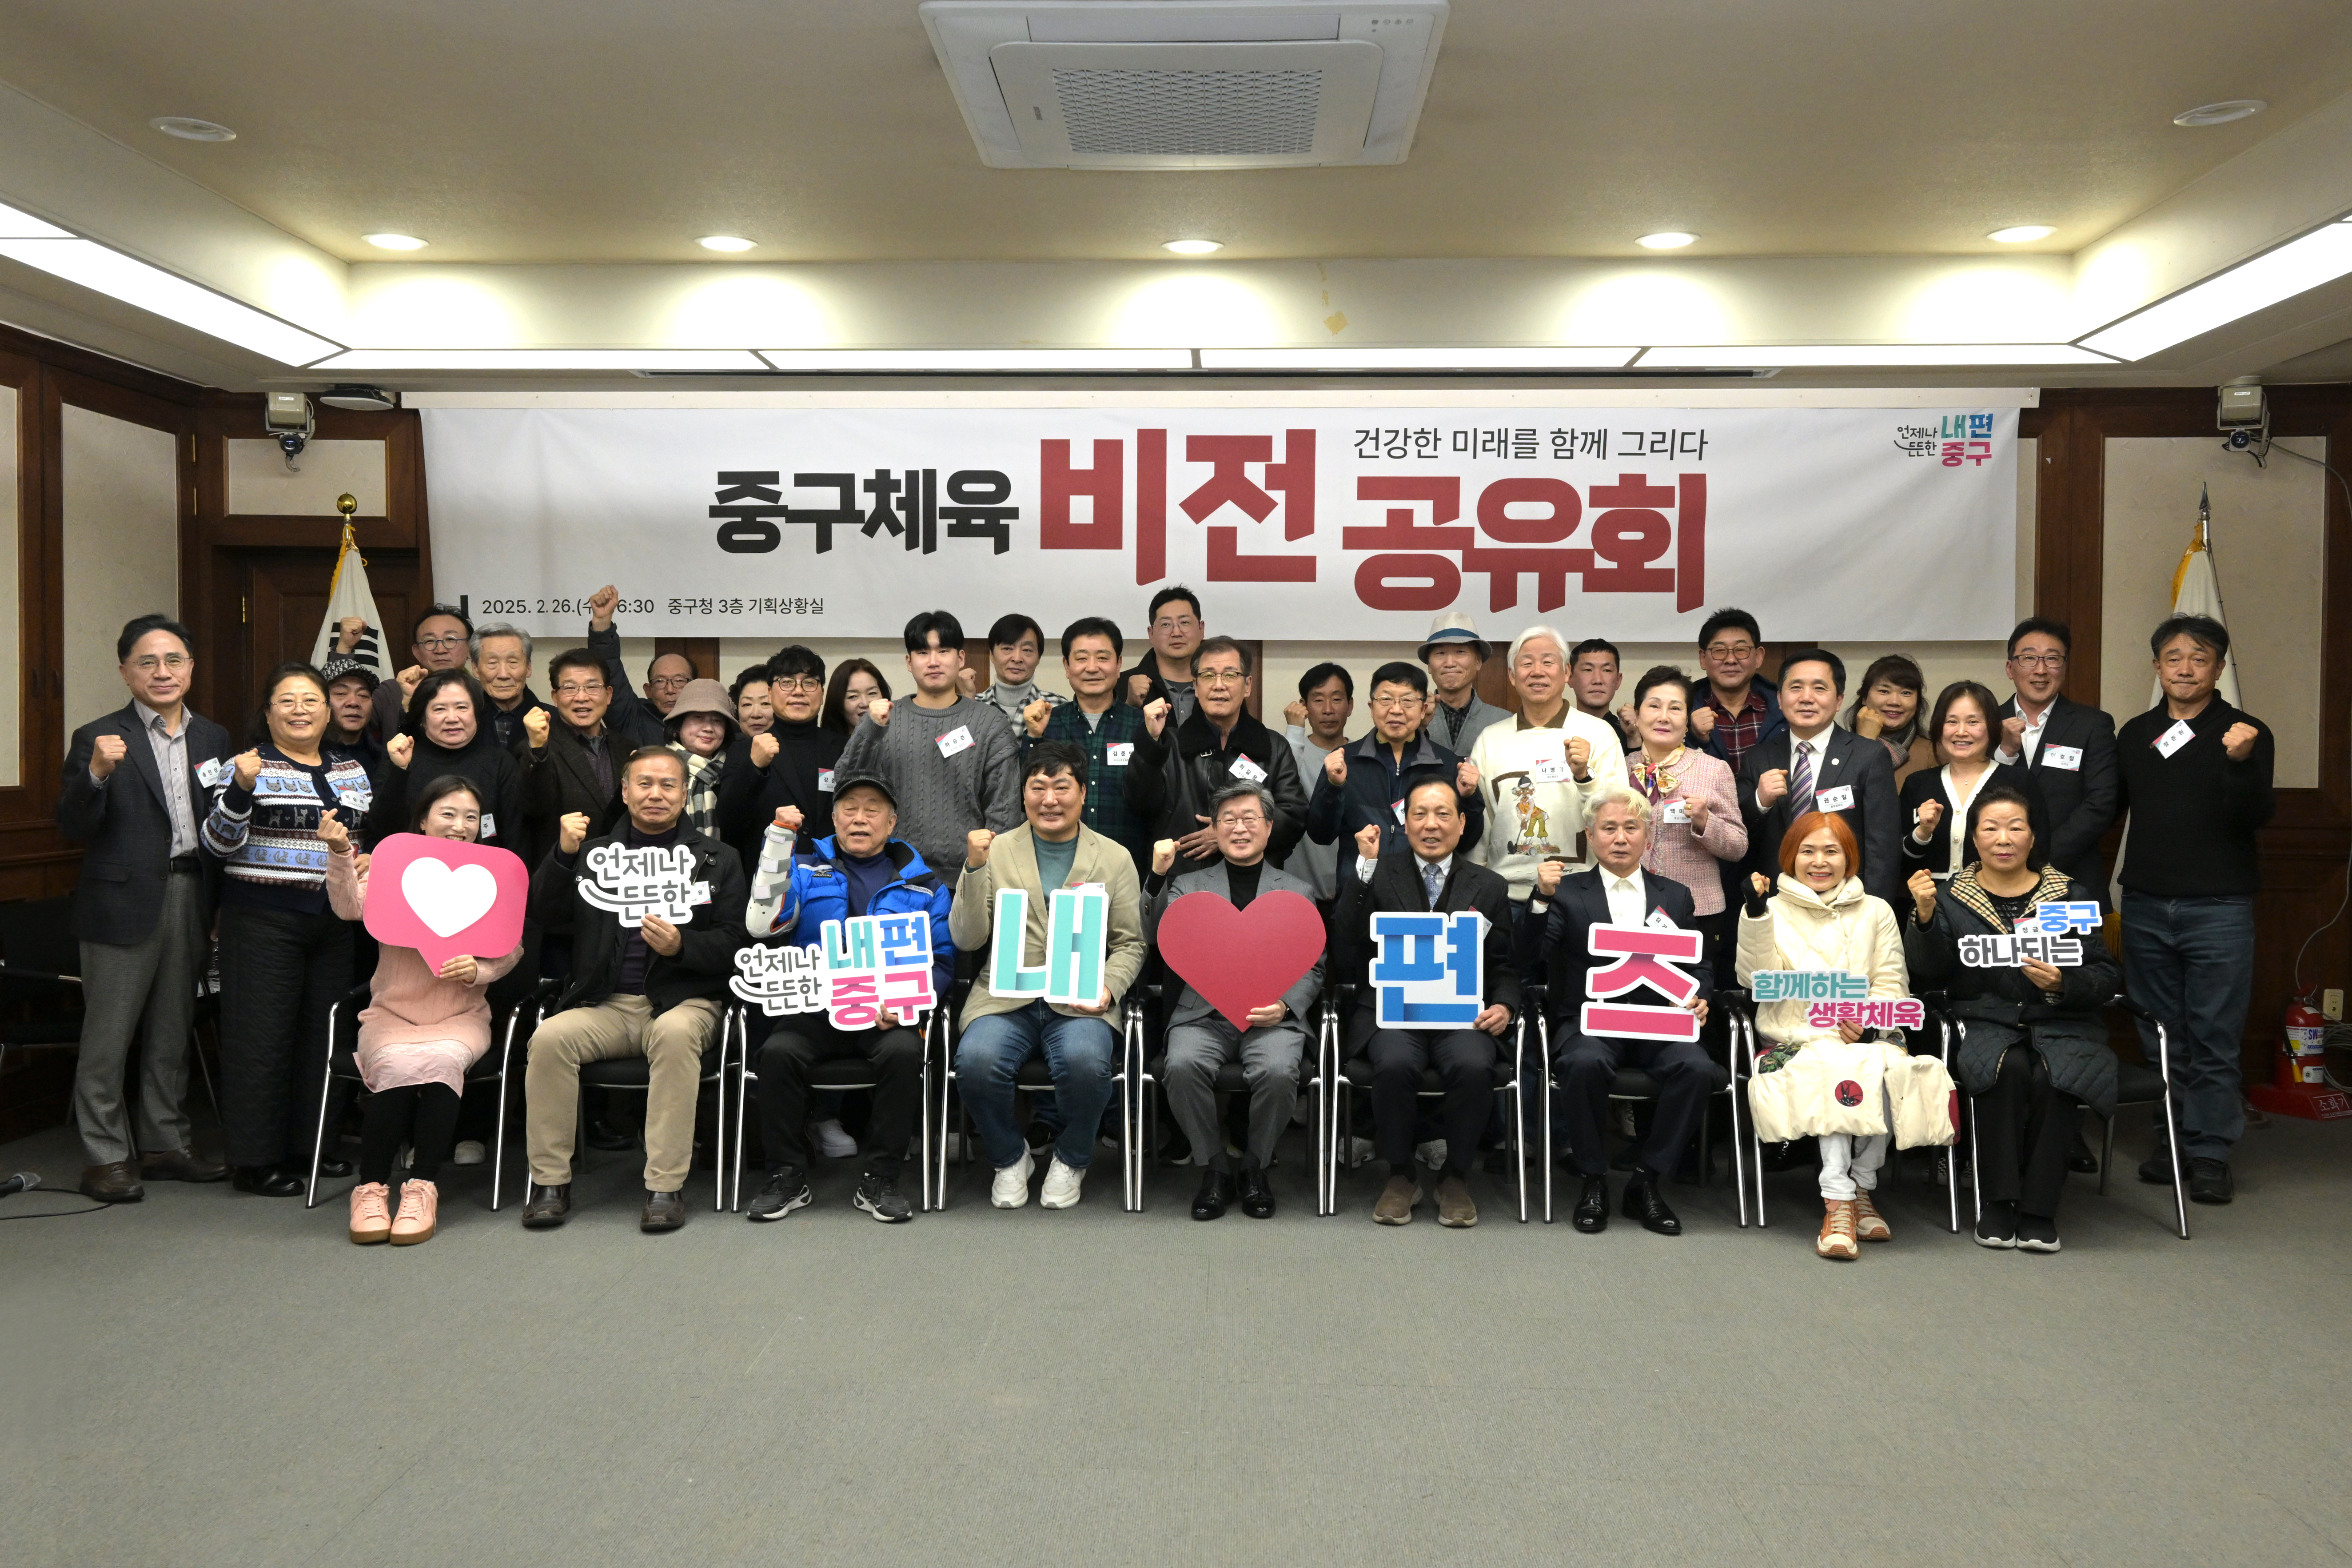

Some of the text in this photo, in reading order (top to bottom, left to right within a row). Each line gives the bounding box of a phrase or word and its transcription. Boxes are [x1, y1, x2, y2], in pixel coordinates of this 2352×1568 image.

[1897, 425, 1938, 439] 언제나
[1943, 413, 1993, 439] 내편
[1354, 428, 1709, 461] 건강한 미래를 함께 그리다
[1894, 440, 1937, 457] 든든한
[1942, 442, 1992, 467] 중구
[709, 469, 1020, 555] 중구체육
[1040, 429, 1317, 586] 비전
[1343, 473, 1707, 613] 공유회
[482, 599, 531, 614] 2025.
[668, 598, 713, 615] 중구청
[718, 598, 744, 615] 3층
[749, 598, 824, 615] 기획상황실
[593, 847, 690, 882] 언제나
[2039, 904, 2099, 932] 중구
[826, 916, 929, 970] 내편
[996, 894, 1103, 1000] 내
[1962, 936, 2079, 965] 하나되는
[740, 949, 820, 977] 언제나
[1375, 917, 1479, 1022] 편
[831, 970, 932, 1025] 중구
[1754, 973, 1867, 999] 함께하는
[1808, 1001, 1923, 1028] 생활체육
